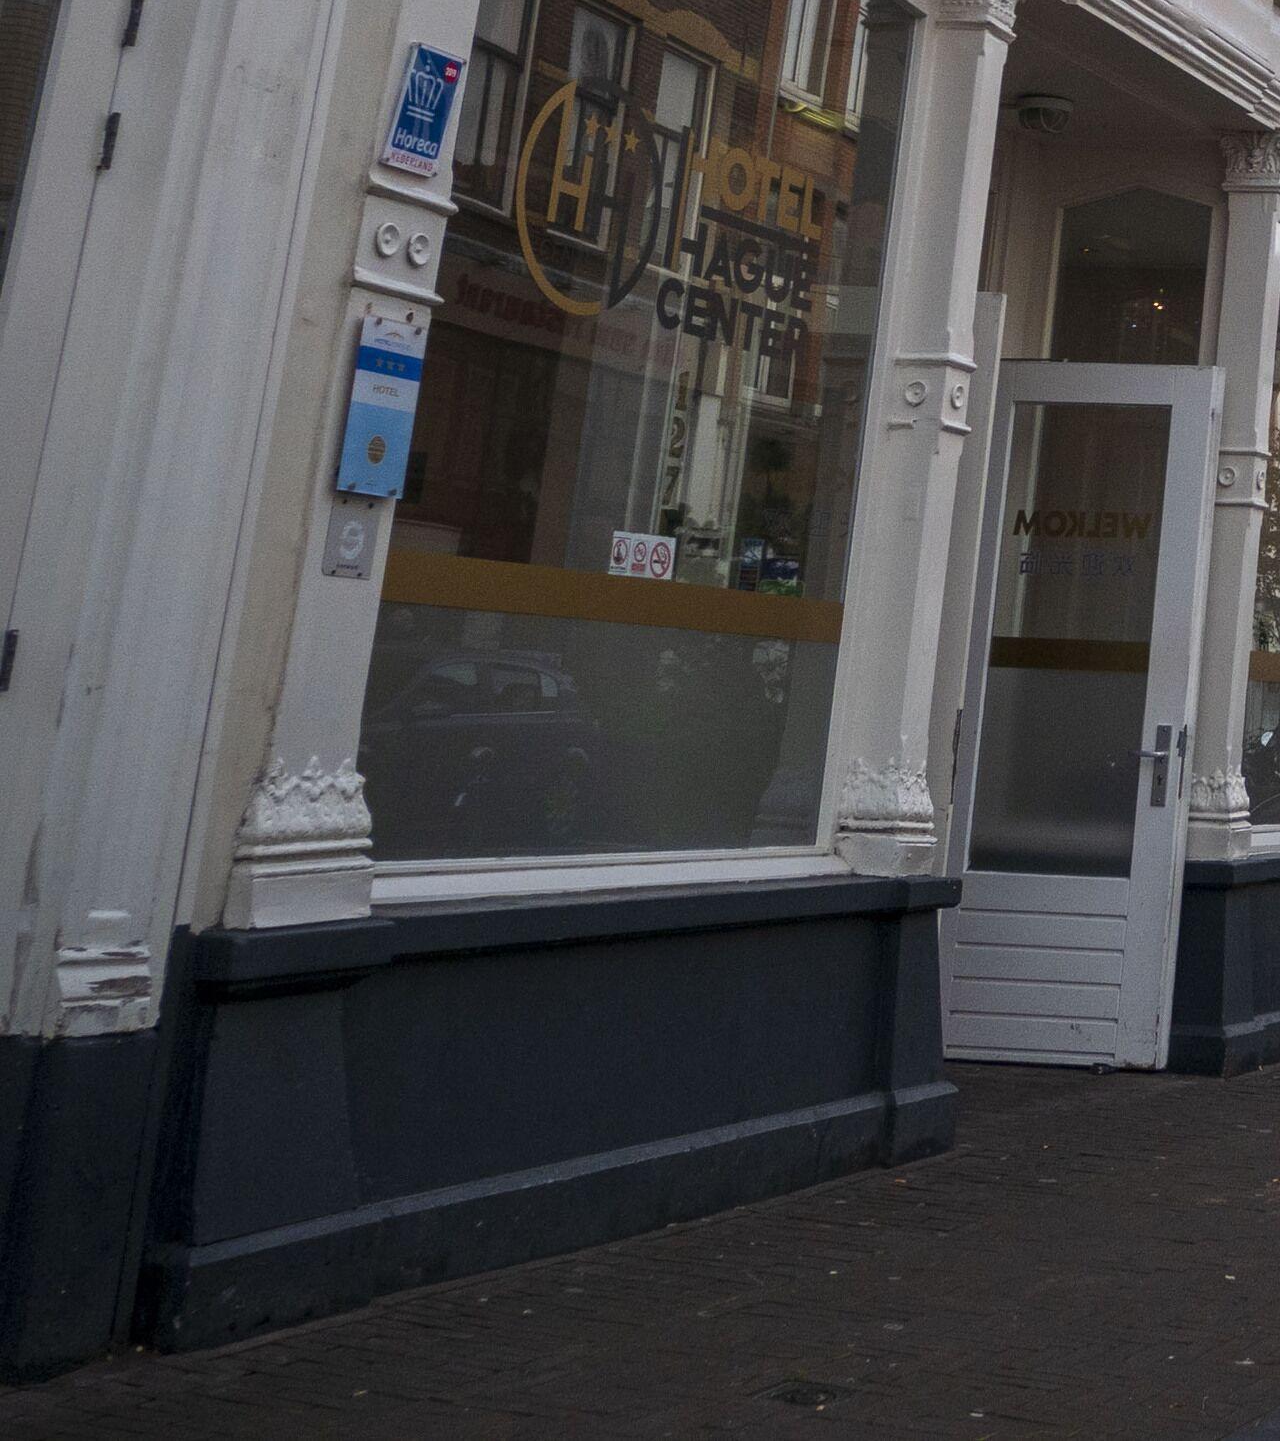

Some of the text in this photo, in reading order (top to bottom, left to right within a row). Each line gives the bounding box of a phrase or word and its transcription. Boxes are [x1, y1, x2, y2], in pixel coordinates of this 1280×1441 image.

[394, 126, 438, 156] Horeca
[676, 125, 823, 241] HOTEL
[664, 221, 820, 314] HAGUE
[656, 277, 809, 364] CENTER
[372, 383, 400, 399] HOTEL
